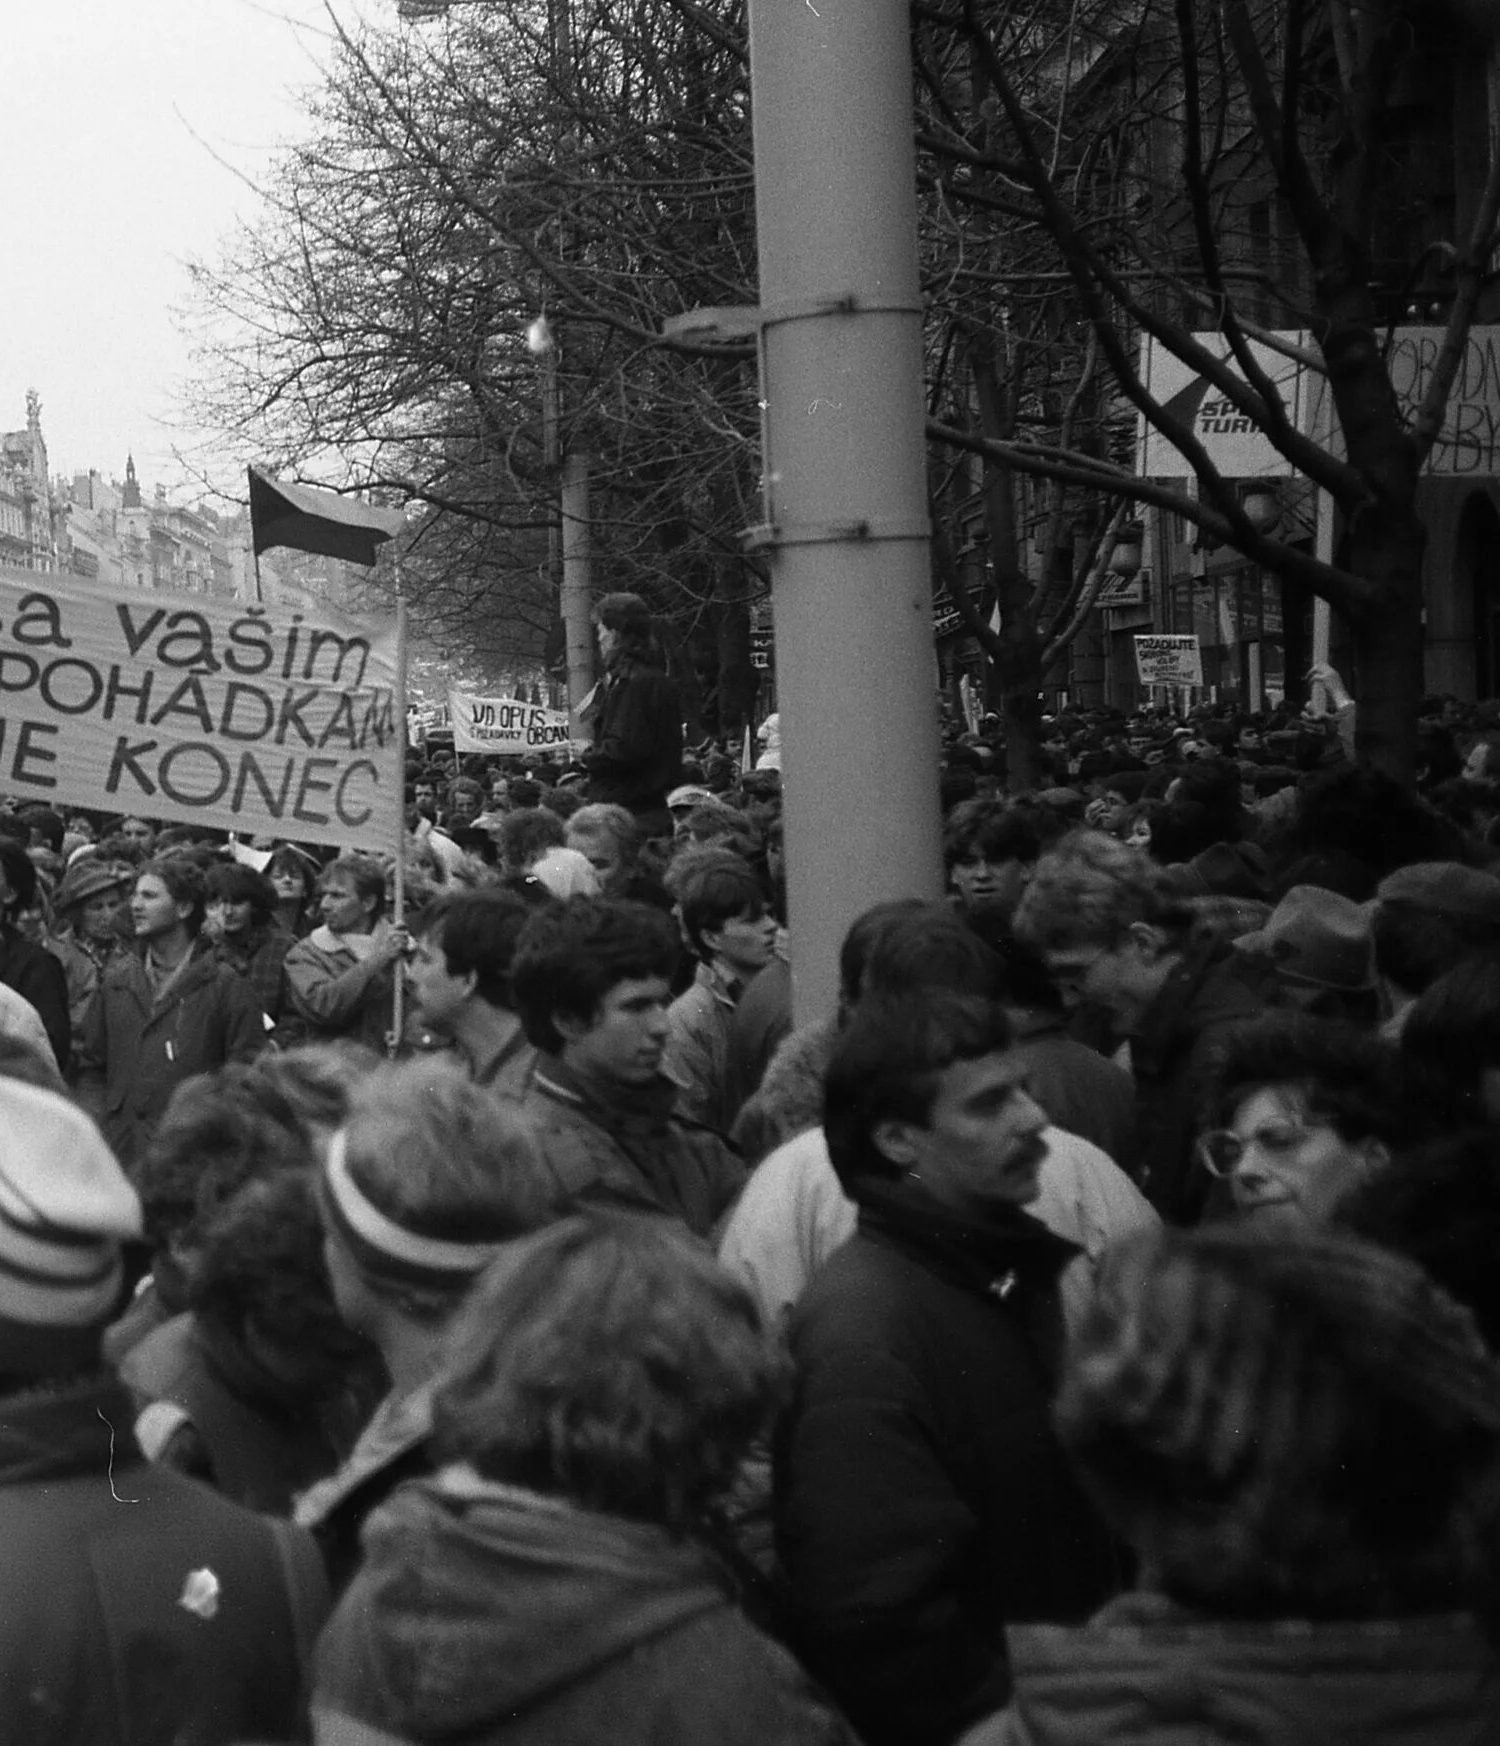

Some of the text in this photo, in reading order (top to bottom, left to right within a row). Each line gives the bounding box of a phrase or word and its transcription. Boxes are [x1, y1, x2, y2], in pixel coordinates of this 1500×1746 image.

[115, 603, 371, 691] vašim
[500, 705, 546, 729] OPUS
[105, 735, 380, 828] KONEC
